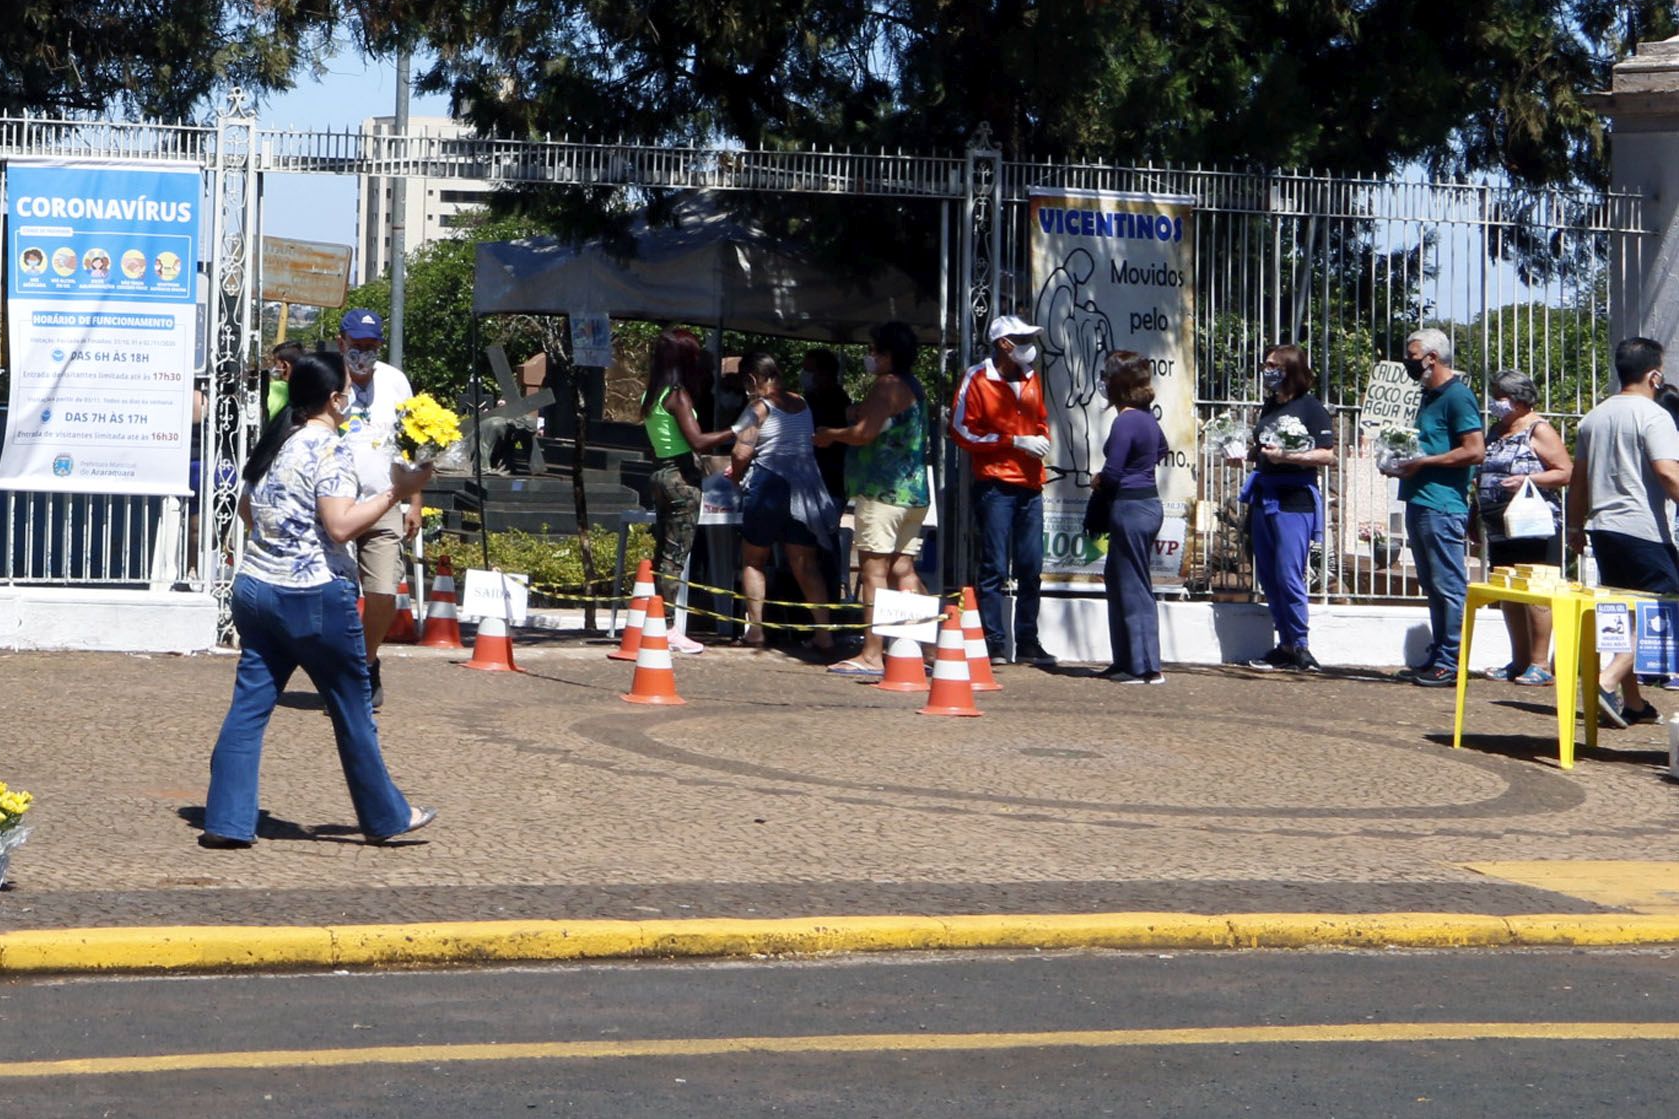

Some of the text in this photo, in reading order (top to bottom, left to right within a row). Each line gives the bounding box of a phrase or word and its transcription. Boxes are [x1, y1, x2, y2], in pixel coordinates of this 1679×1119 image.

[16, 195, 192, 223] CORONAVÍRUS
[1039, 208, 1183, 243] VICENTINOS
[1111, 259, 1184, 287] Movidos
[33, 313, 174, 328] HORÁRIO DE FUNCIONAMENTO
[1130, 307, 1168, 334] pelo
[71, 351, 91, 361] DAS
[95, 352, 110, 362] 6H
[131, 353, 149, 363] 18H
[152, 372, 182, 382] 17h30
[1372, 363, 1409, 384] CALDO
[1368, 384, 1401, 403] COCO
[65, 412, 88, 423] DAS
[92, 412, 106, 423] 7H
[128, 413, 148, 424] 17H
[1363, 400, 1400, 418] AGUA
[151, 432, 179, 442] 16h30
[91, 469, 135, 478] Araraquara
